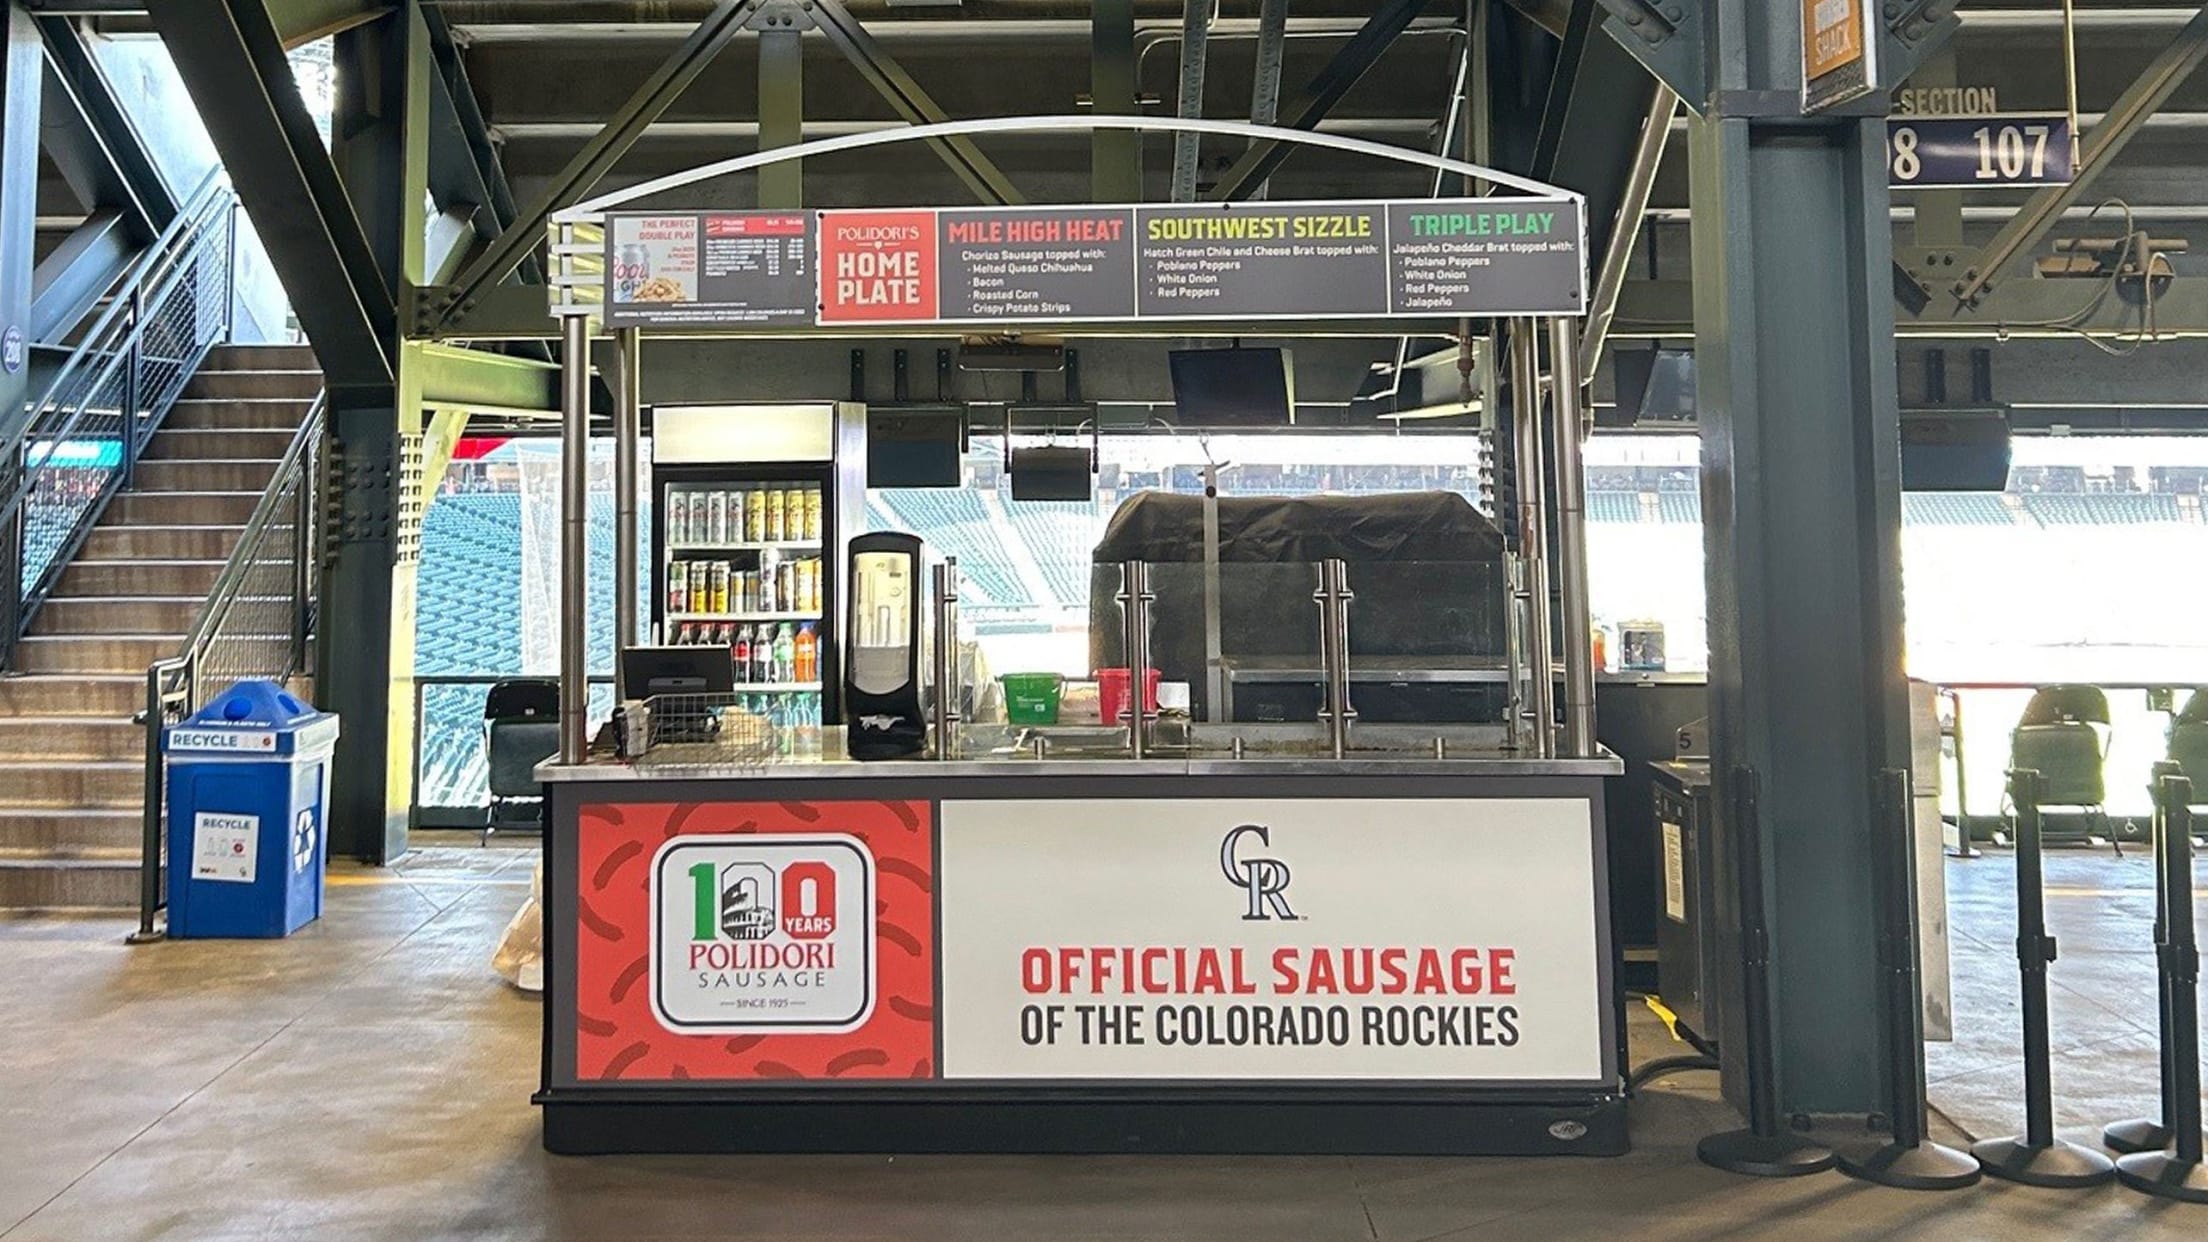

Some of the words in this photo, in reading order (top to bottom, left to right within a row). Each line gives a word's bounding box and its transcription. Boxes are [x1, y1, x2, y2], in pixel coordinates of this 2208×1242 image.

[1901, 87, 1996, 115] SECTION
[1973, 125, 2049, 179] 107
[642, 220, 657, 229] THE
[660, 219, 695, 228] PERFECT
[948, 221, 1002, 243] MILE
[1006, 220, 1060, 242] HIGH
[1066, 219, 1123, 241] HEAT
[1148, 217, 1288, 240] SOUTHWEST
[1293, 216, 1371, 238] SIZZLE
[1410, 214, 1491, 236] TRIPLE
[1495, 212, 1554, 234] PLAY
[639, 231, 673, 240] DOUBLE
[674, 230, 695, 240] PLAY
[837, 226, 920, 241] POLIDORI'S
[962, 250, 999, 262] Chorizo
[1002, 250, 1044, 263] Sausage
[1045, 249, 1080, 262] topped
[1082, 248, 1106, 260] with:
[1143, 247, 1174, 258] Hatch
[1176, 247, 1205, 258] Green
[1207, 246, 1231, 257] Chile
[1233, 246, 1252, 257] and
[1254, 245, 1291, 256] Cheese
[1293, 245, 1315, 256] Brat
[1317, 245, 1352, 257] topped
[1354, 244, 1379, 255] with:
[1392, 243, 1440, 256] Jalapeño
[1442, 242, 1484, 254] Cheddar
[1487, 242, 1509, 253] Brat
[1511, 241, 1547, 254] topped
[1549, 240, 1574, 252] with:
[837, 251, 920, 278] HOME
[972, 263, 1006, 274] Melted
[1008, 263, 1039, 275] Queso
[1040, 262, 1093, 273] Chihuahua
[1157, 260, 1198, 271] Poblano
[1200, 260, 1241, 273] Peppers
[1404, 256, 1446, 268] Poblano
[1448, 256, 1490, 269] Peppers
[972, 277, 1005, 288] Bacon
[1157, 273, 1187, 284] White
[1188, 273, 1218, 284] Onion
[1404, 270, 1435, 281] White
[1437, 269, 1466, 281] Onion
[837, 279, 921, 305] PLATE
[972, 290, 1014, 301] Roasted
[1016, 290, 1039, 300] Corn
[1157, 286, 1177, 297] Red
[1179, 286, 1220, 299] Peppers
[1405, 283, 1425, 294] Red
[1427, 282, 1470, 296] Peppers
[972, 303, 1004, 316] Crispy
[1006, 302, 1039, 314] Potato
[1041, 301, 1072, 314] Strips
[1405, 296, 1453, 309] Jalapeño
[172, 733, 238, 747] RECYCLE
[1679, 732, 1692, 749] 5
[202, 818, 251, 830] RECYCLE
[688, 862, 837, 941] 100
[785, 917, 832, 933] YEARS
[688, 943, 836, 971] POLIDORI
[1021, 947, 1257, 995] OFFICIAL
[1272, 947, 1517, 995] SAUSAGE
[698, 972, 826, 989] SAUSAGE
[736, 999, 766, 1009] SINCE
[769, 999, 789, 1008] 1925
[1021, 1005, 1065, 1046] OF
[1075, 1004, 1145, 1046] THE
[1156, 1004, 1350, 1046] COLORADO
[1362, 1004, 1519, 1046] ROCKIES
